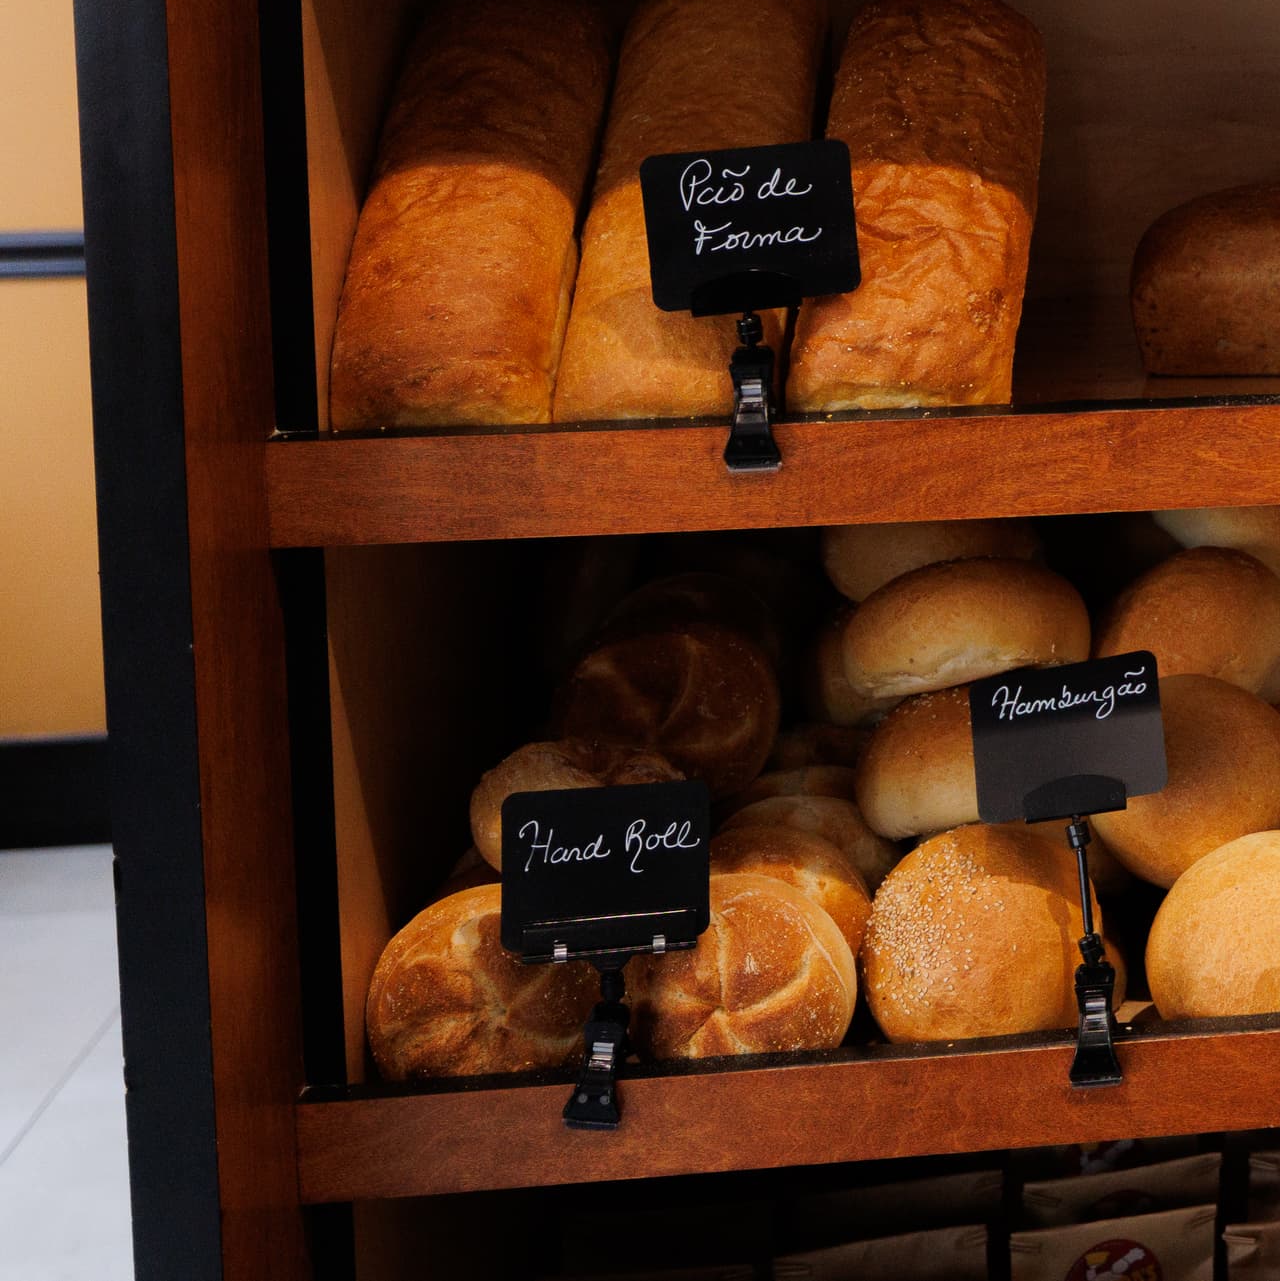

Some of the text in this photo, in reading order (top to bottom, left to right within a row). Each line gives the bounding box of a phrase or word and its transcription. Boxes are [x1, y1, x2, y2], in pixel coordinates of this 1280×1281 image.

[756, 166, 814, 198] de
[692, 217, 823, 255] Forma
[518, 818, 700, 874] Hard Roll
